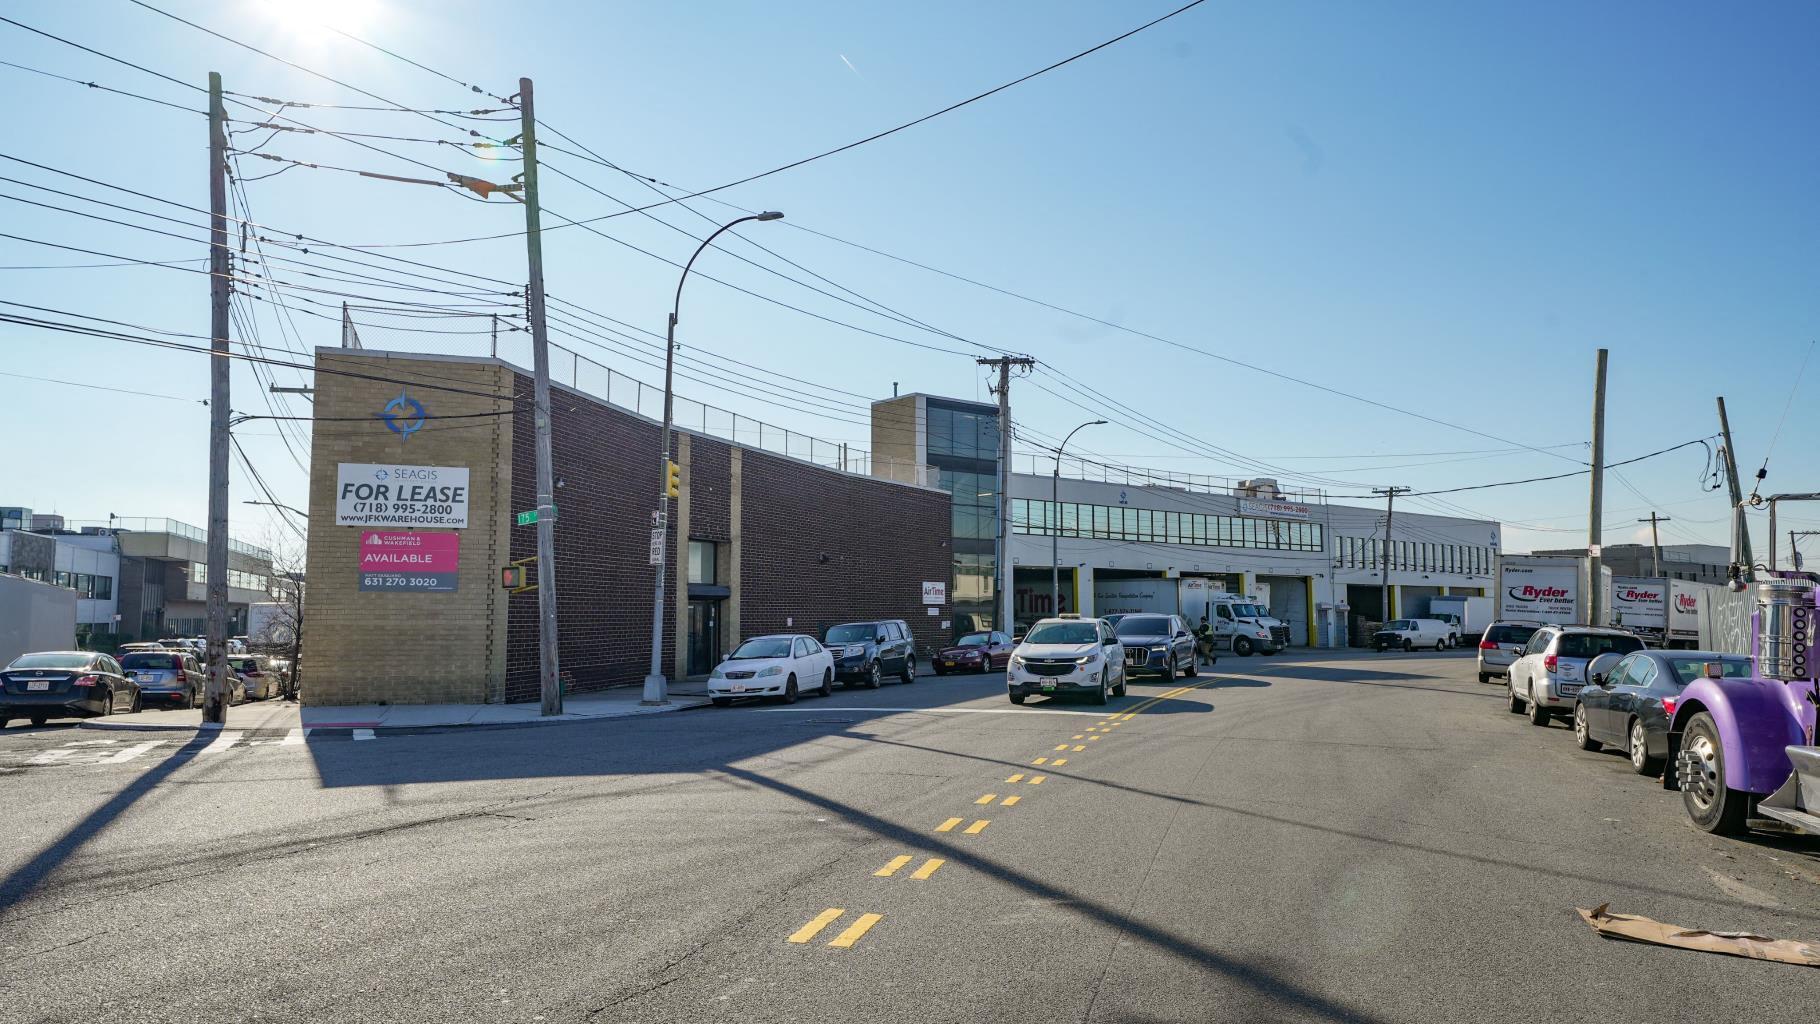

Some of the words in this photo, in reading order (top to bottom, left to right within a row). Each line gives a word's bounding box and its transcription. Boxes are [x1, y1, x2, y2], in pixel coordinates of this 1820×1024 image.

[394, 468, 438, 480] SEAGIS
[341, 483, 390, 501] FOR
[396, 485, 465, 504] LEASE
[353, 502, 389, 513] (718)
[392, 503, 453, 515] 995-2800
[518, 512, 530, 524] 175
[364, 553, 433, 563] AVAILABLE
[364, 577, 382, 586] 631
[385, 577, 407, 586] 270
[409, 578, 438, 586] 3020
[1522, 585, 1568, 598] Ryder
[1626, 590, 1661, 600] Ryder
[1680, 593, 1696, 608] Ryder
